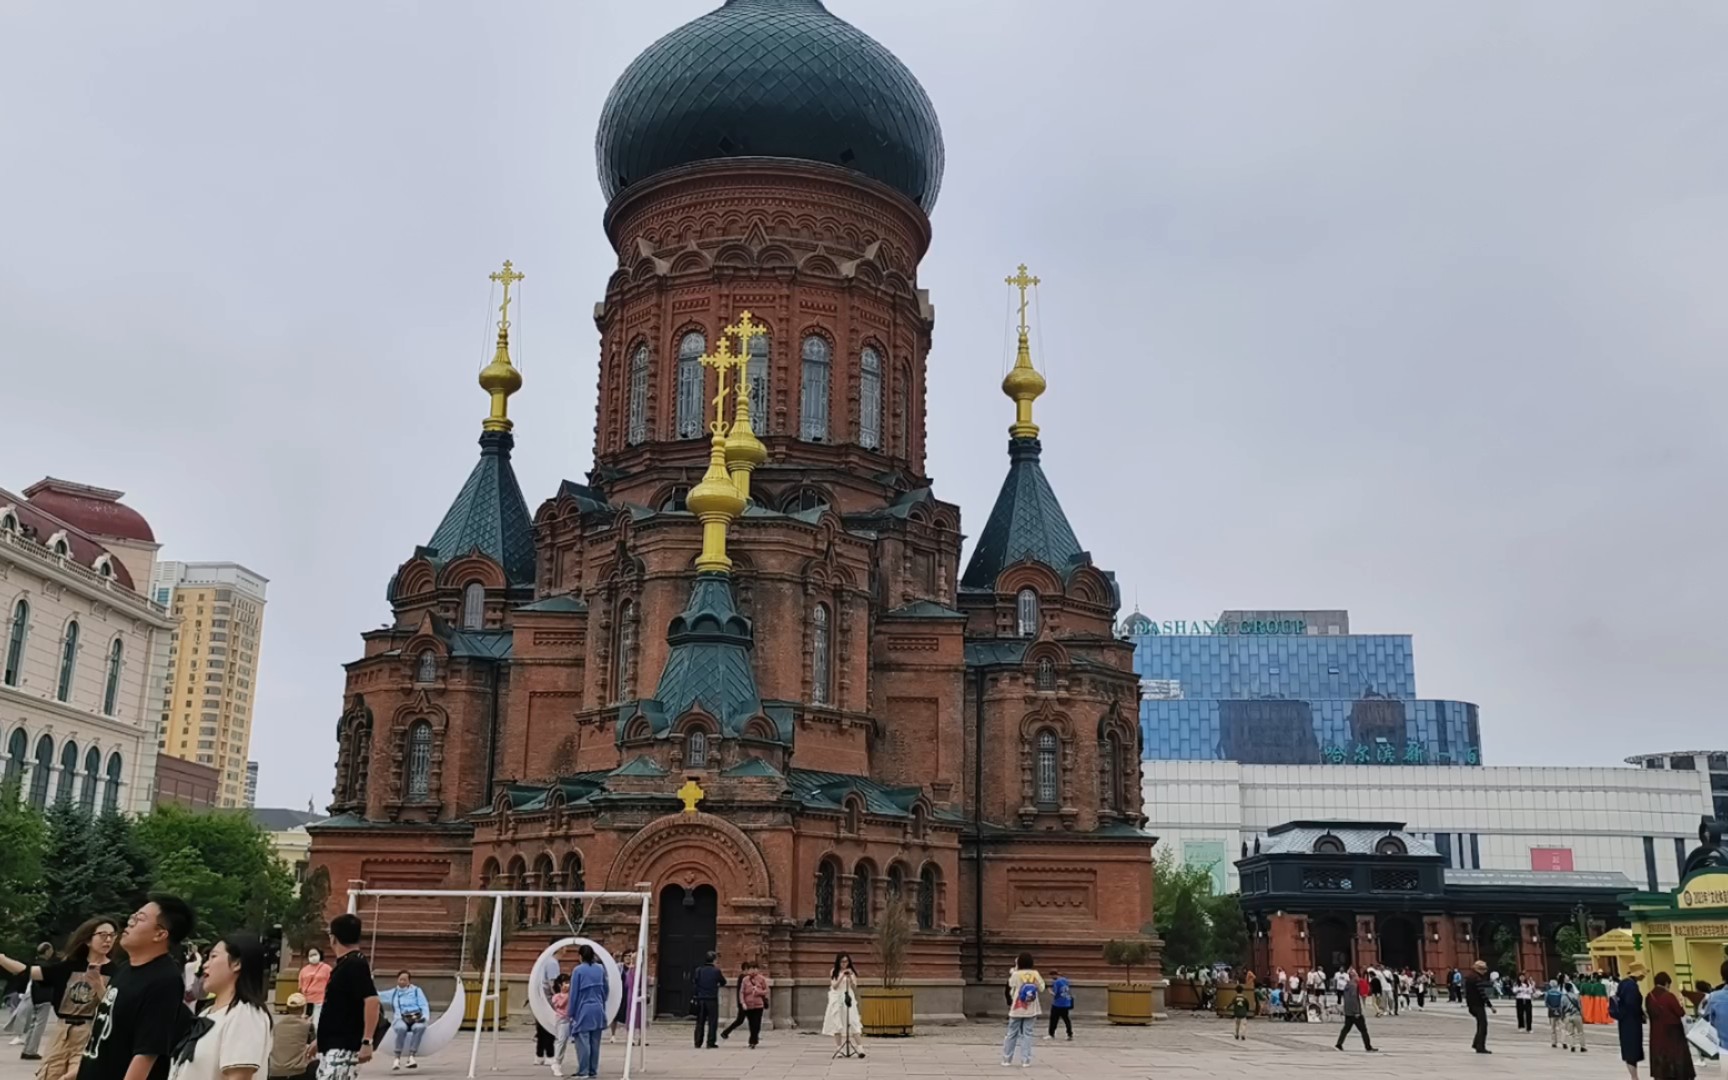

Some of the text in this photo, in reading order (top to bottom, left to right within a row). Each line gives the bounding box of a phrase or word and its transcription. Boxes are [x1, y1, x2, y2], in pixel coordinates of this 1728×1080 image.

[1135, 620, 1307, 635] DASHANG GROUP
[1325, 741, 1478, 764] 哈尔滨新一百
